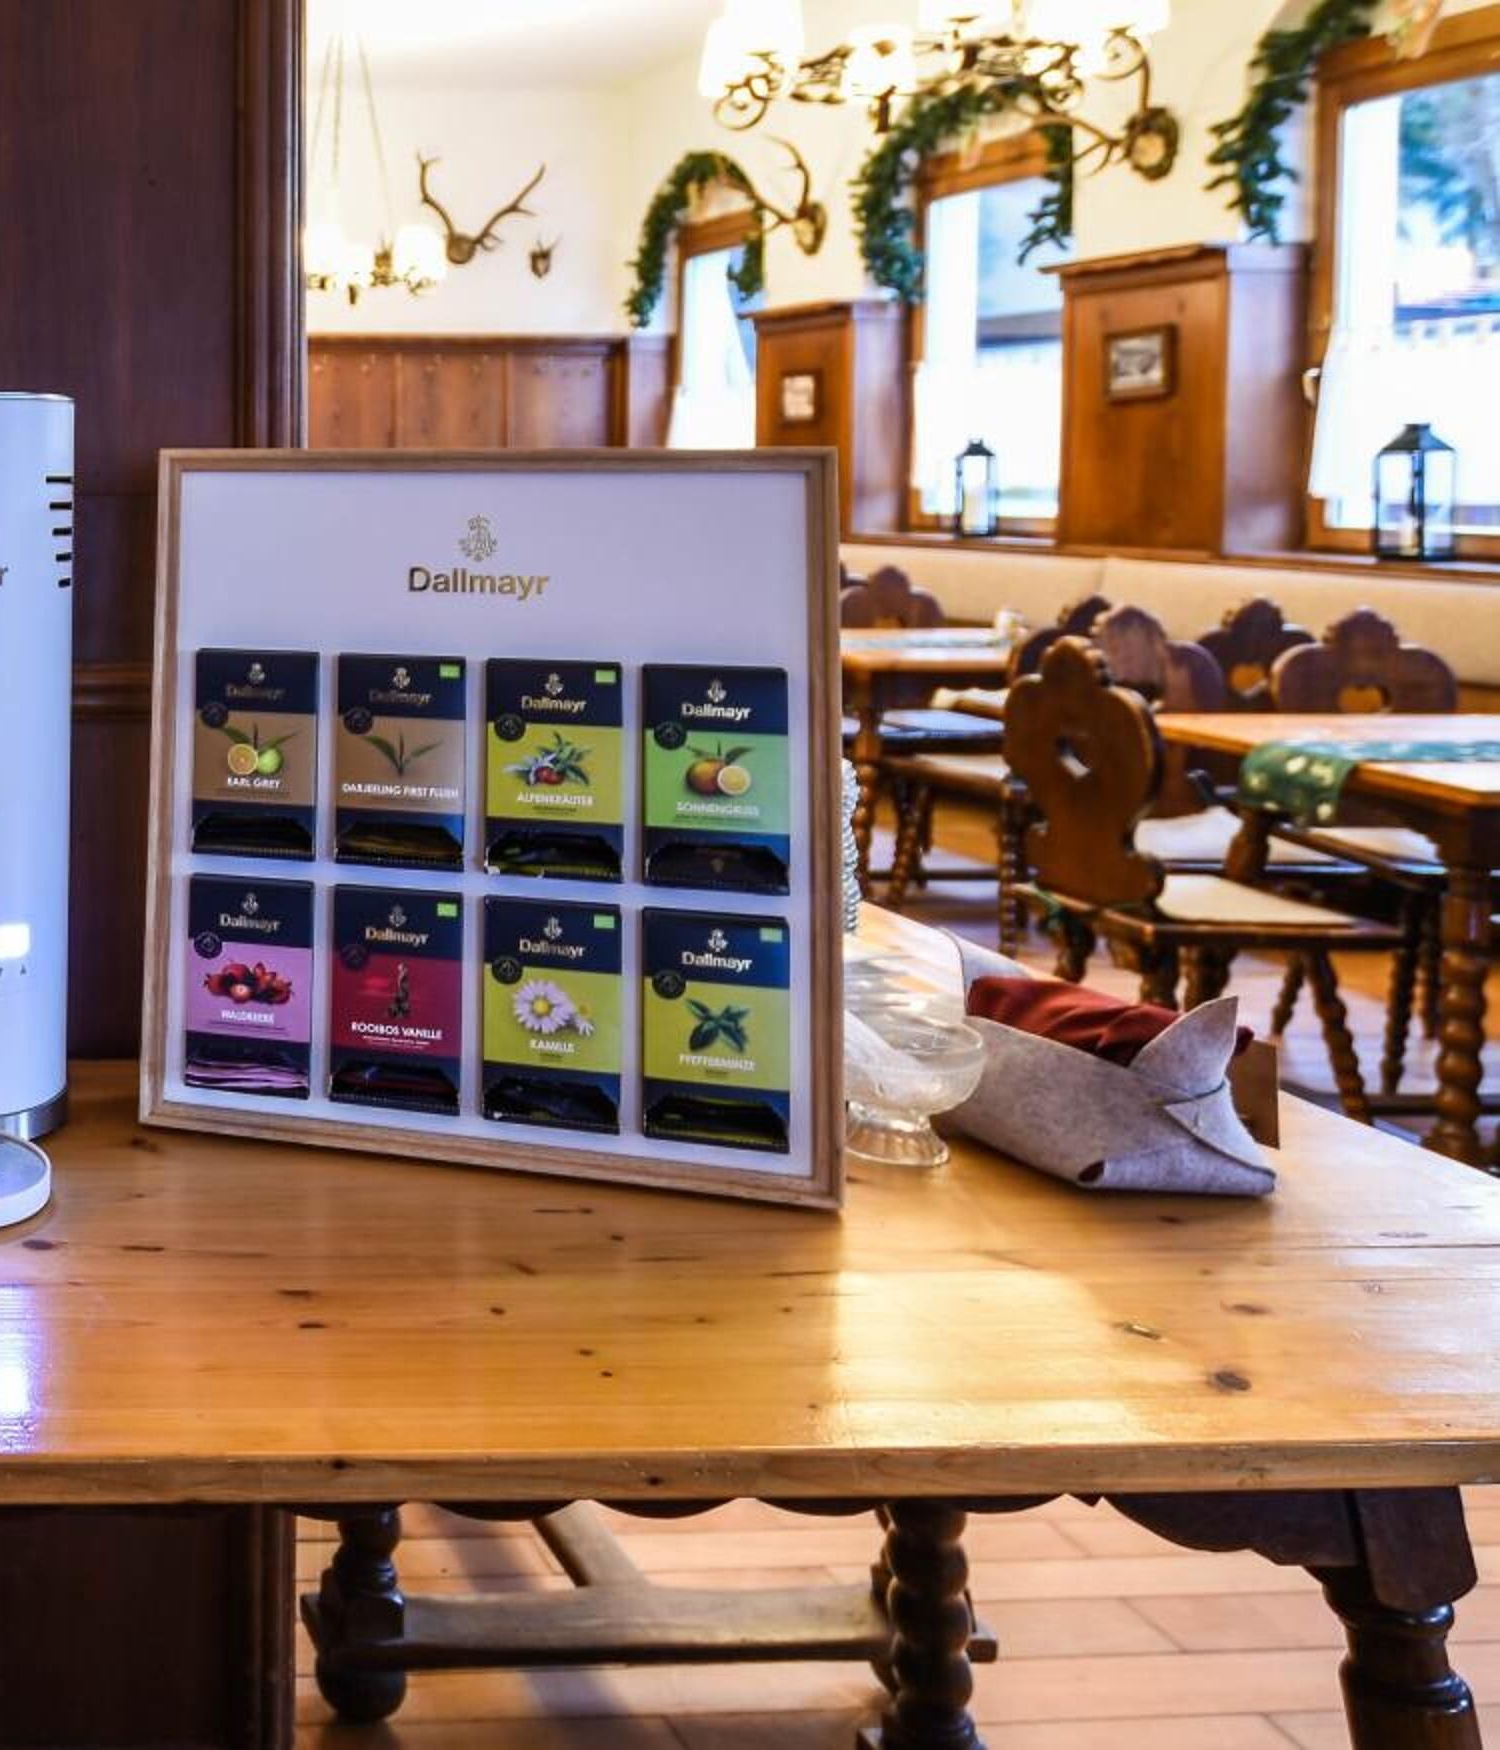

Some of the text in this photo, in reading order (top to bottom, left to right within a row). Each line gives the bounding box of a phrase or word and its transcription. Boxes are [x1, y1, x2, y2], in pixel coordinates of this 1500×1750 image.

[408, 566, 550, 601] Dallmayr
[520, 695, 588, 713] Dallmayr
[680, 703, 752, 721] Dallmayr
[227, 776, 281, 789] EARL GREY
[341, 783, 401, 796] DARJEELING
[219, 913, 281, 933] Dallmayr
[364, 927, 429, 947] Dallmayr
[519, 939, 586, 959] Dallmayr
[681, 951, 753, 972] Dallmayr
[351, 1021, 443, 1040] ROOIBOS VANILLE
